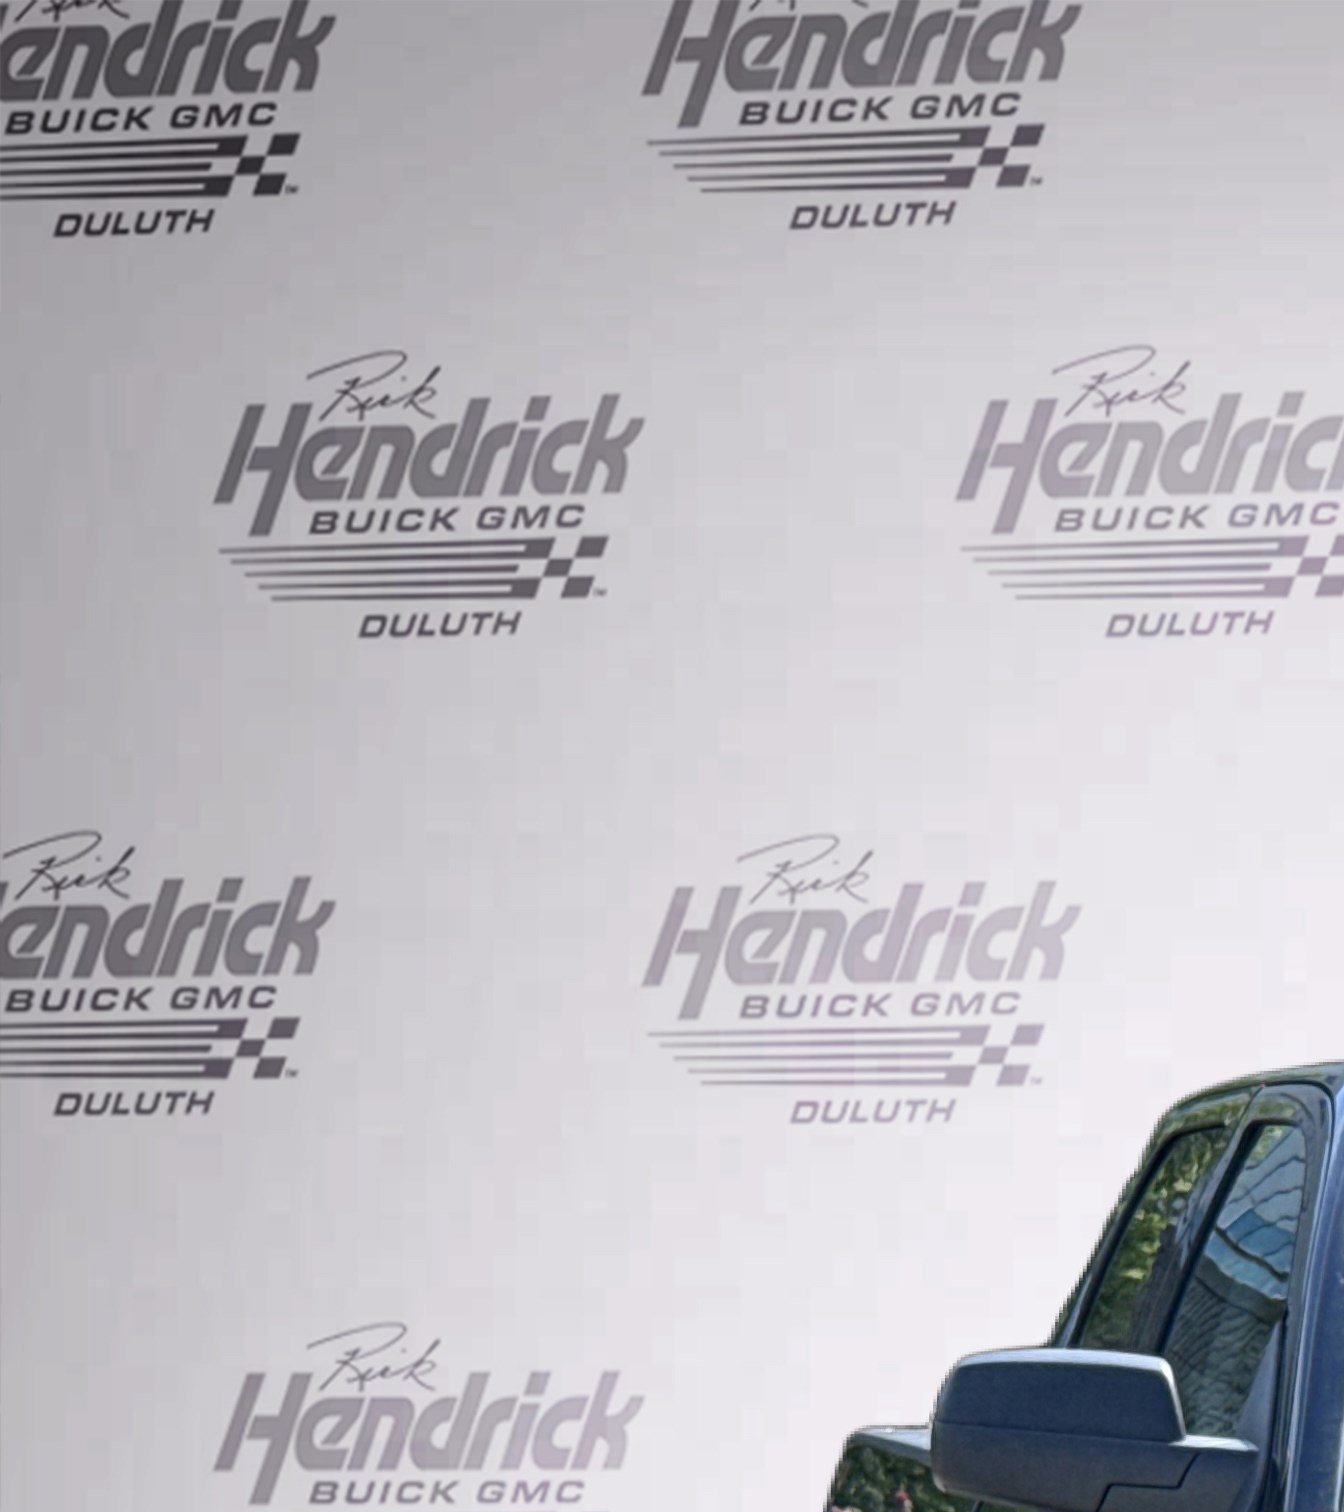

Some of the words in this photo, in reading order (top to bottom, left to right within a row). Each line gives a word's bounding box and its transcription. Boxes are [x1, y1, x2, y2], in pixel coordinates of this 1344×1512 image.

[0, 0, 335, 103] endrick
[641, 0, 1081, 129] Hendrick
[5, 107, 152, 135] BUICK
[169, 102, 277, 129] GMC
[739, 97, 892, 125] BUICK
[909, 92, 1021, 120] GMC
[53, 209, 214, 237] DULUTH
[789, 201, 956, 230] DULUTH
[213, 394, 644, 537] Hendrick
[309, 508, 458, 534] BUICK
[476, 504, 585, 530] GMC
[1054, 505, 1209, 532] BUICK
[1227, 501, 1340, 528] GMC
[358, 612, 521, 638] DULUTH
[1105, 611, 1274, 638] DULUTH
[0, 876, 335, 981] endrick
[641, 880, 1081, 1021] Hendrick
[5, 987, 152, 1013] BUICK
[169, 985, 277, 1010] GMC
[739, 993, 891, 1019] BUICK
[909, 991, 1021, 1017] GMC
[53, 1091, 214, 1117] DULUTH
[789, 1099, 956, 1125] DULUTH
[213, 1370, 644, 1506] Hendrick
[309, 1480, 458, 1505] BUICK
[476, 1479, 585, 1504] GMC
